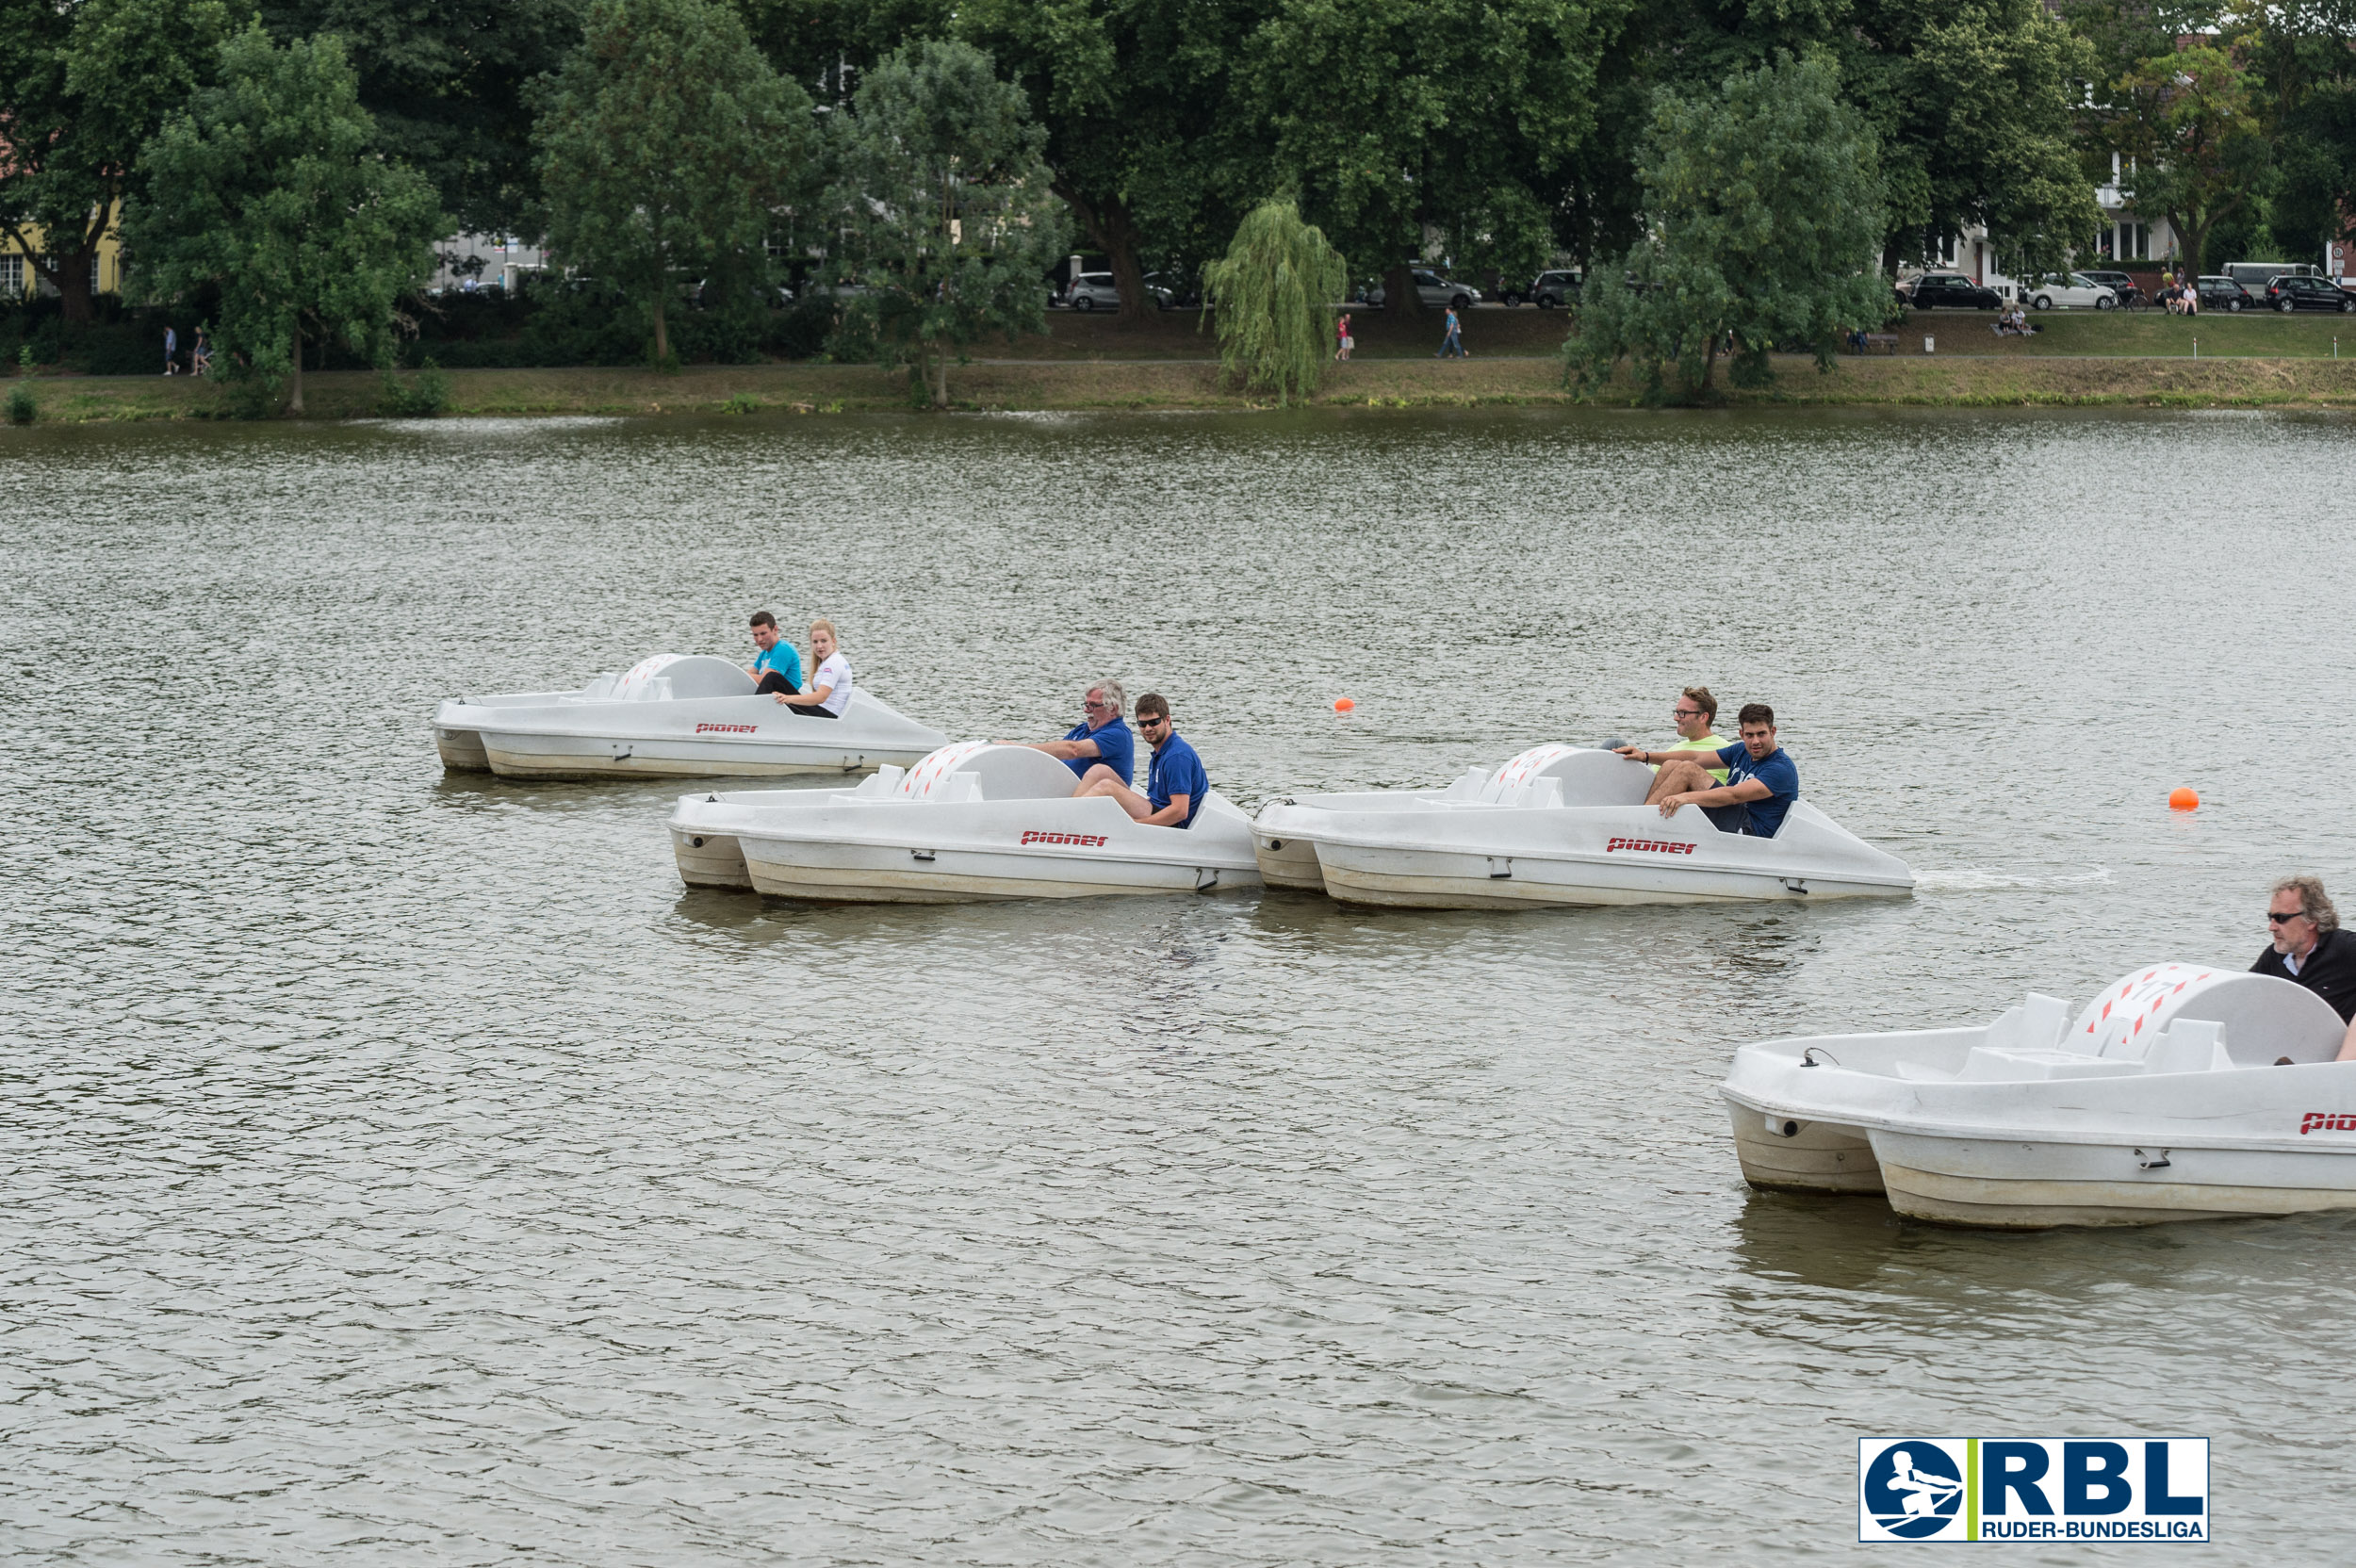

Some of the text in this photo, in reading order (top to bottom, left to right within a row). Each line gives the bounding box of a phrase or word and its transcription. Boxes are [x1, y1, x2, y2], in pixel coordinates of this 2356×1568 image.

[695, 723, 759, 733] pioner
[1021, 830, 1108, 846] pioner
[1607, 838, 1697, 854] pioner
[2300, 1112, 2356, 1135] pio
